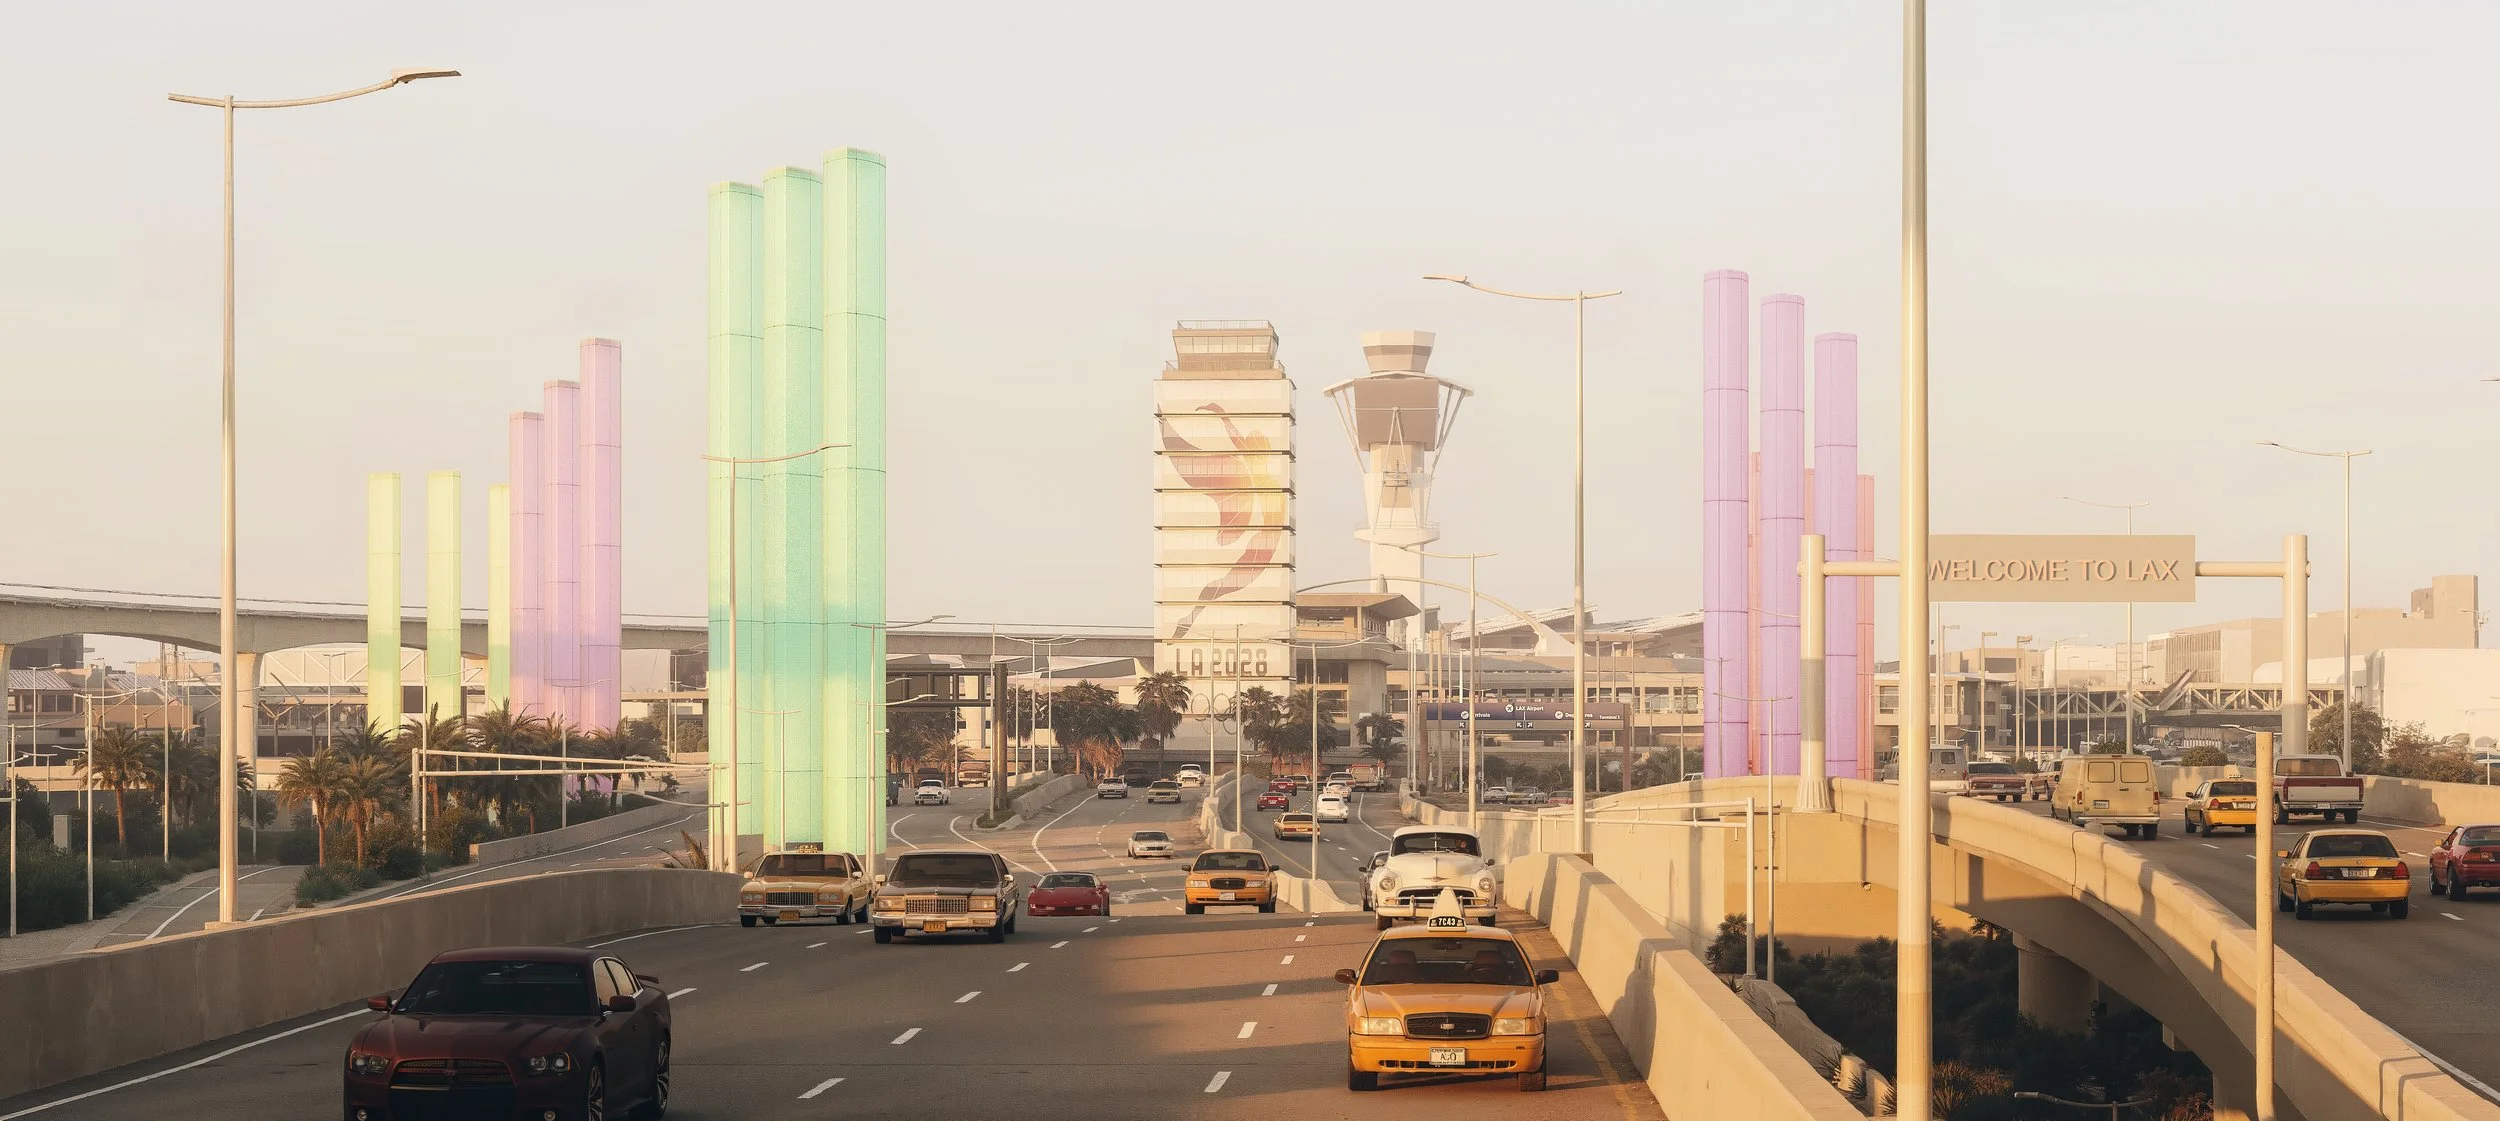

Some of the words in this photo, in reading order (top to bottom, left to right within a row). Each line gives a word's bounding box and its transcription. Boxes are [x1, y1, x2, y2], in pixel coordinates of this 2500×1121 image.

[1928, 559, 2069, 582] WELCOME
[2077, 559, 2117, 582] TO
[2125, 559, 2180, 582] LAX
[1176, 648, 1203, 676] LA
[1211, 648, 1268, 676] 2028
[1438, 917, 1456, 926] 7C43
